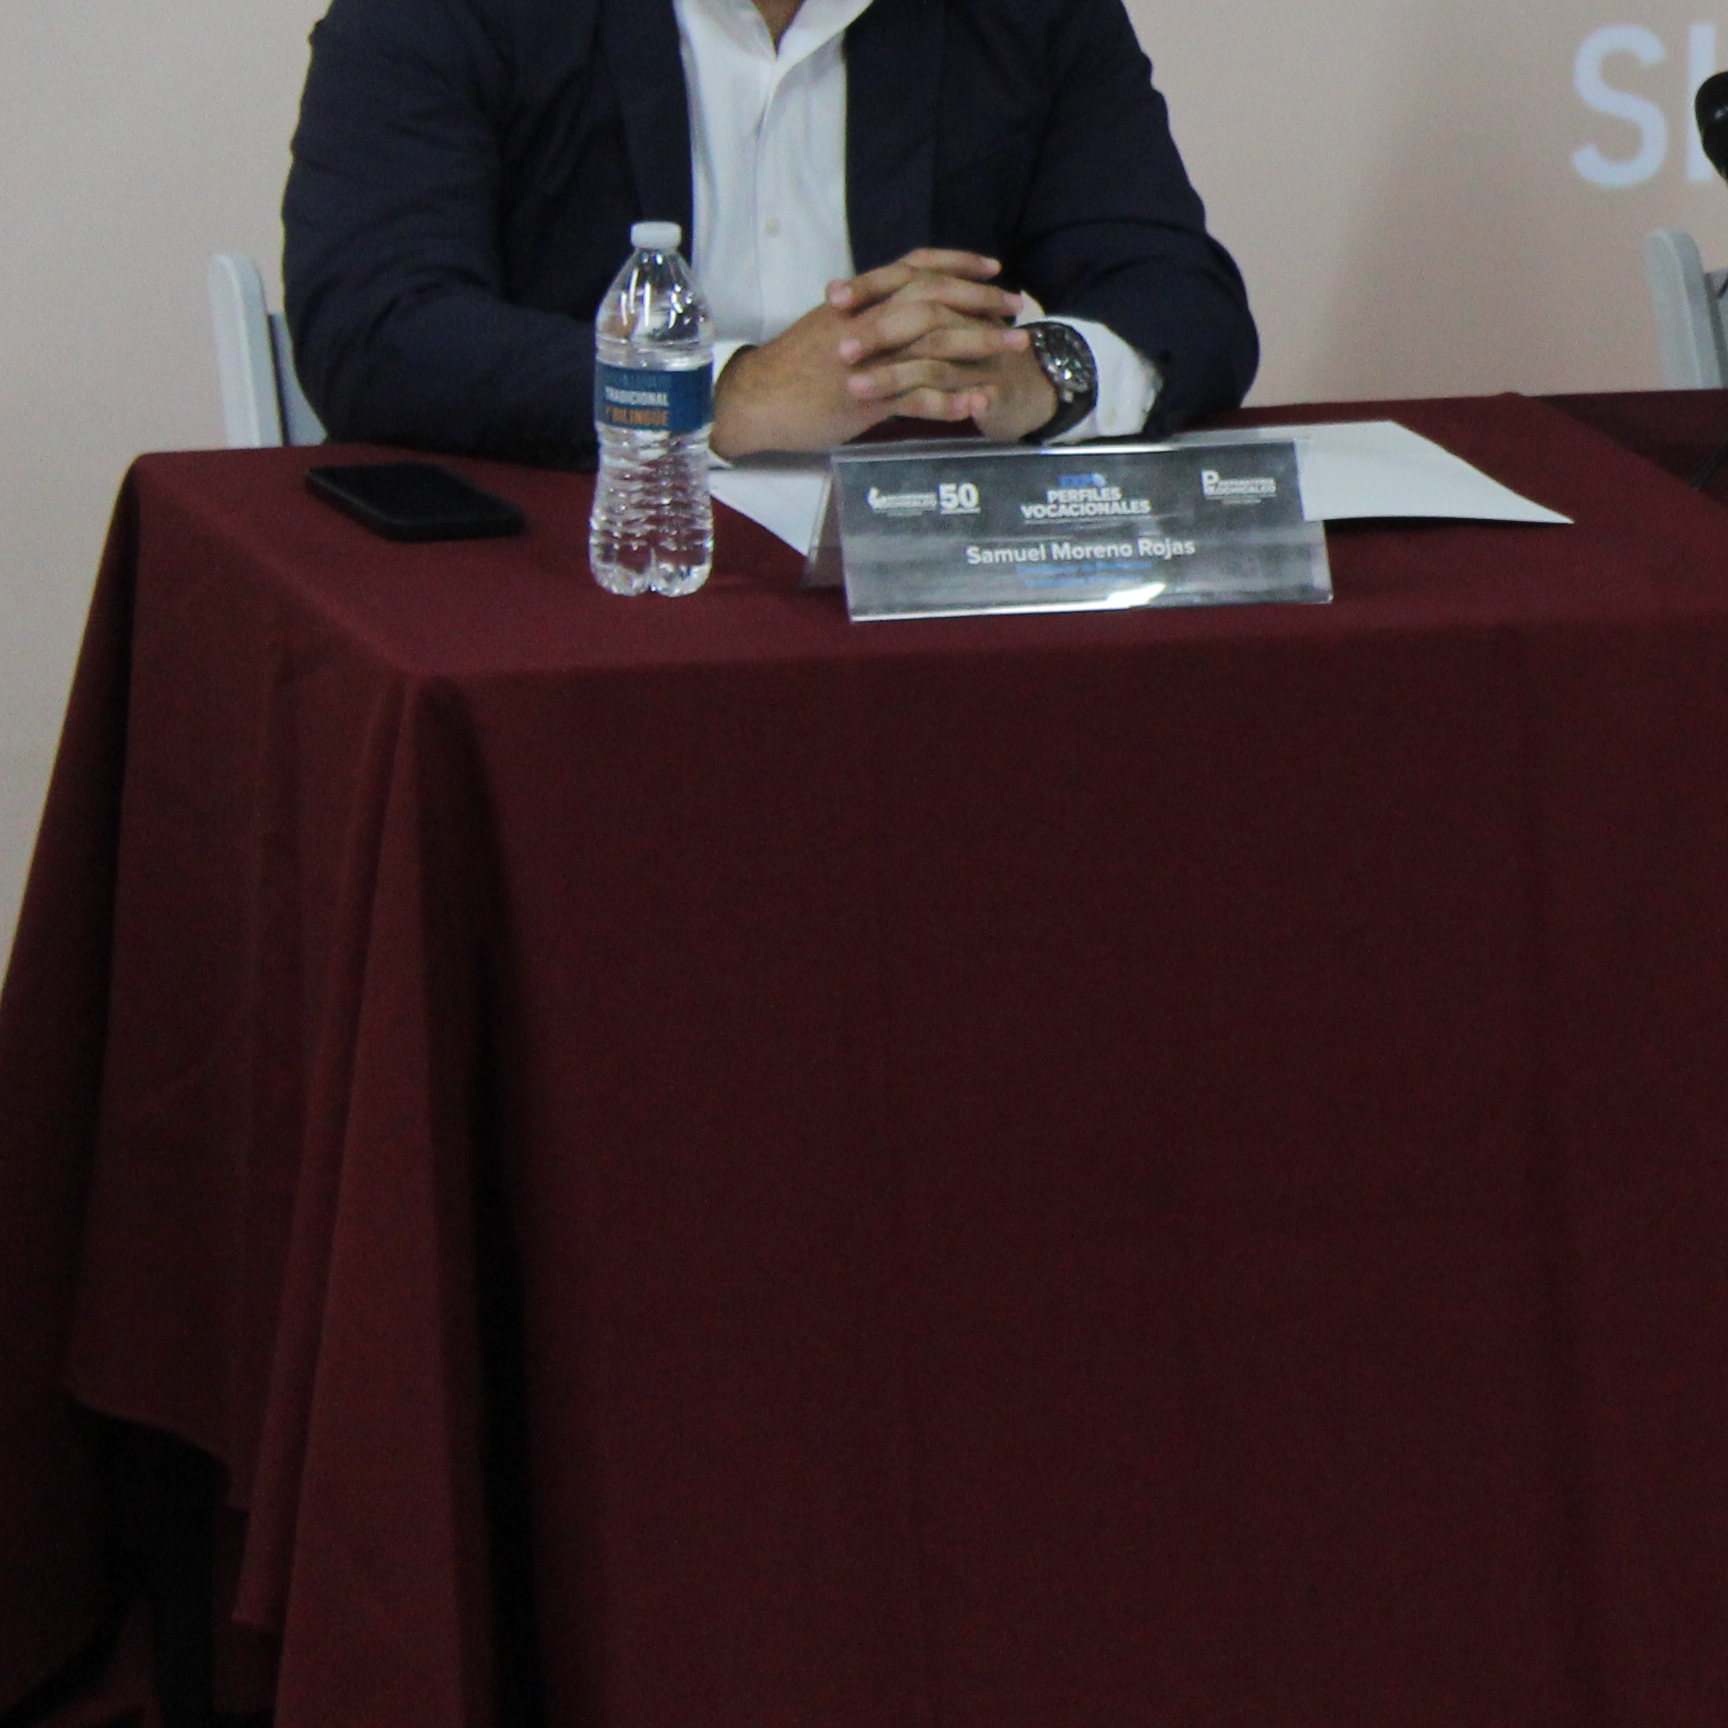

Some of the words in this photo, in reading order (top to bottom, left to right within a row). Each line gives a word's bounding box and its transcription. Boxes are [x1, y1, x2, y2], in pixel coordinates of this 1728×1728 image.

[938, 482, 980, 509] 50
[1046, 486, 1122, 504] PERFILES
[1020, 499, 1151, 519] VOCACIONALES
[965, 543, 1046, 565] Samuel
[1050, 541, 1133, 560] Moreno
[1138, 537, 1196, 560] Rojas
